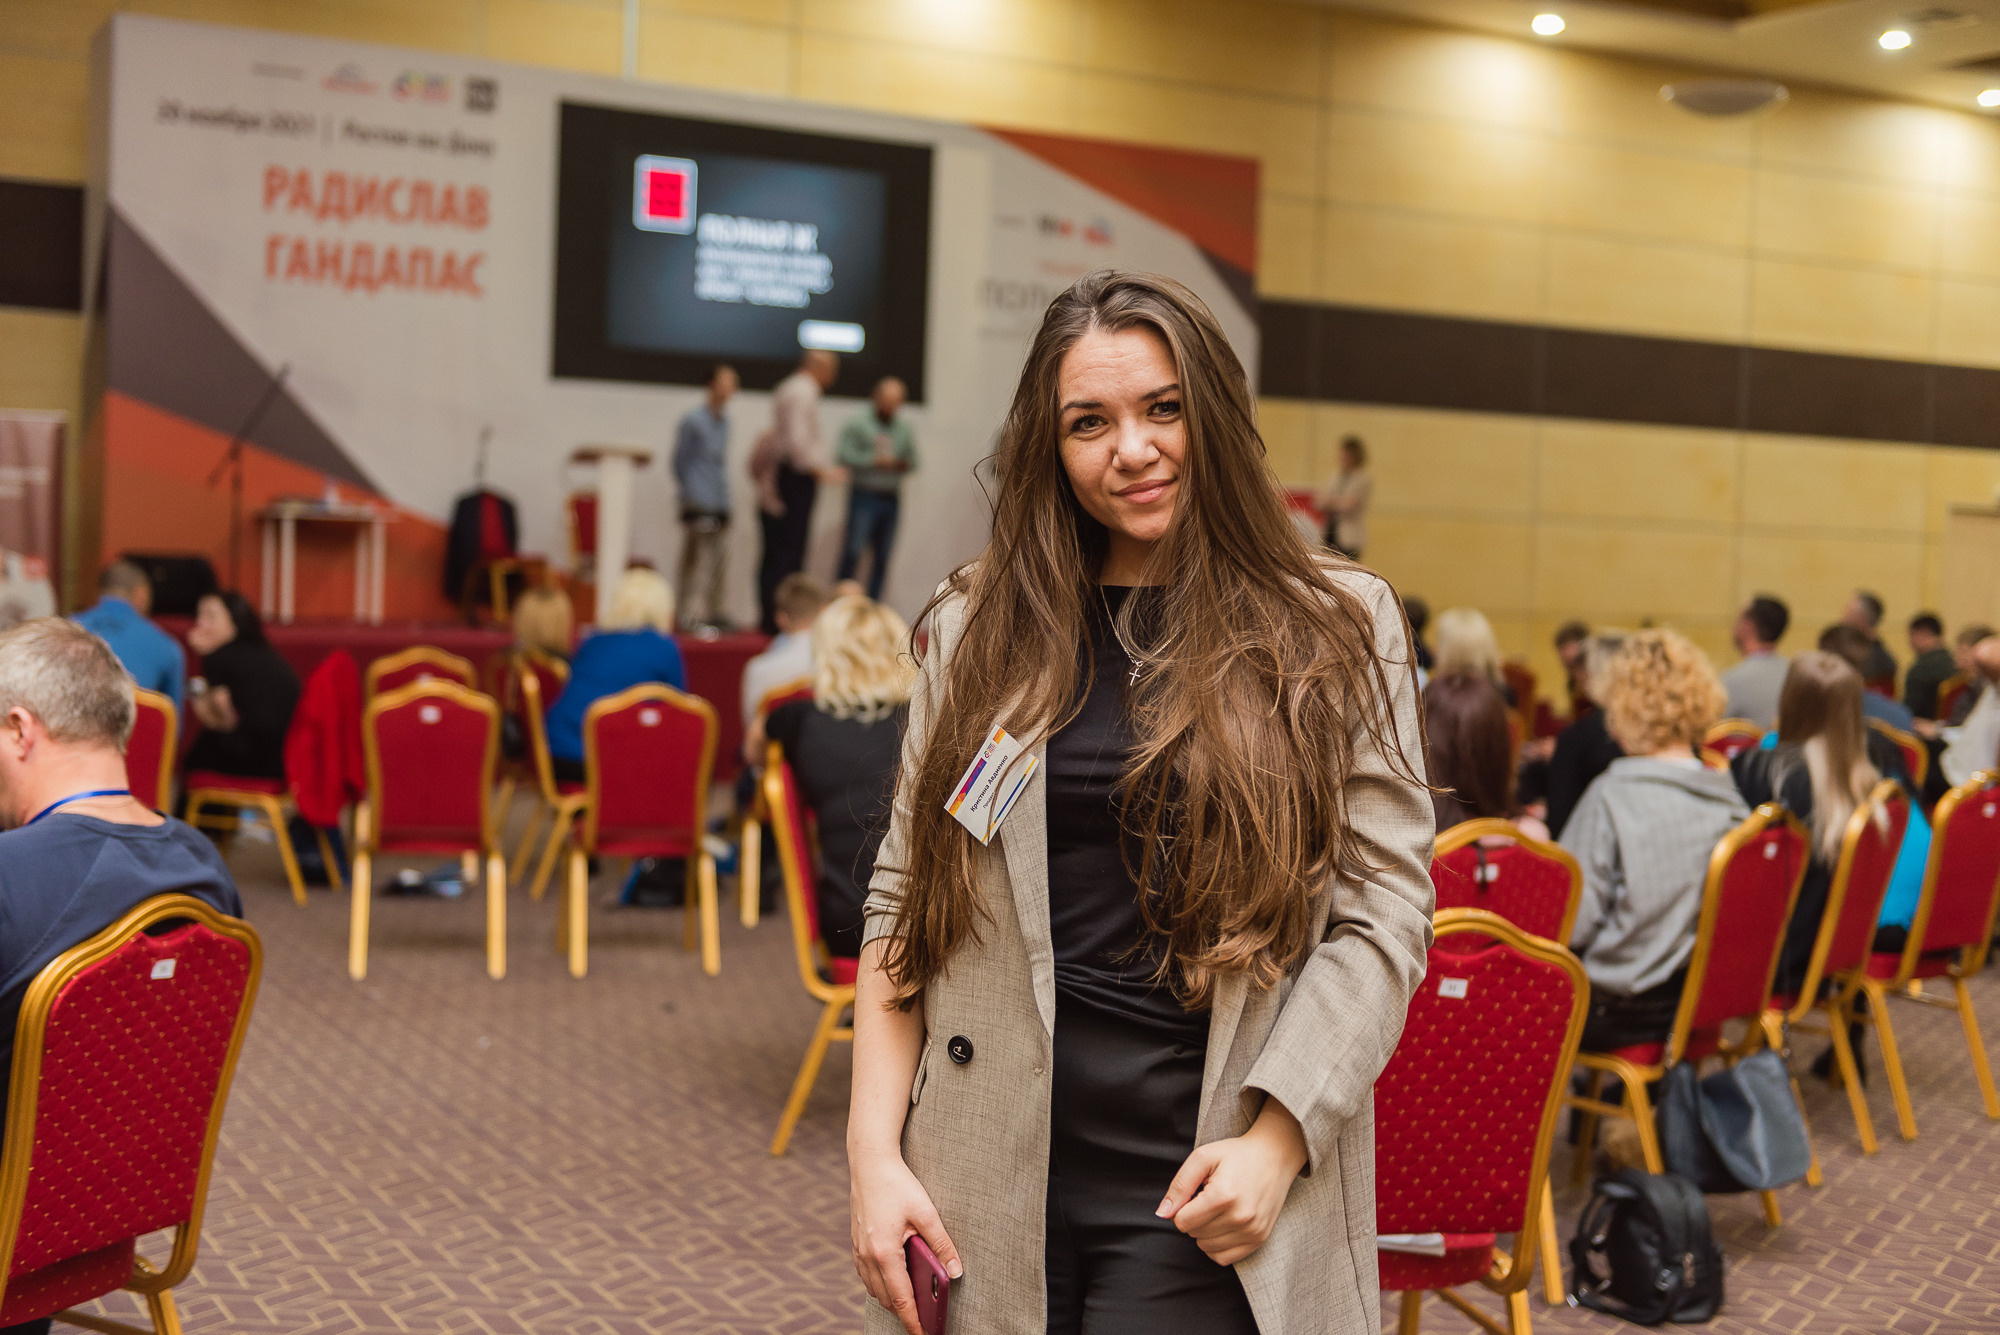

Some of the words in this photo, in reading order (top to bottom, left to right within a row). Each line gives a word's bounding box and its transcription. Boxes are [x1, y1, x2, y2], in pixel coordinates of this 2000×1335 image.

[263, 164, 491, 231] РАДИСЛАВ
[264, 234, 488, 298] ГАНДАПАС
[970, 784, 990, 812] Кристина
[987, 755, 1008, 785] Авдиенко
